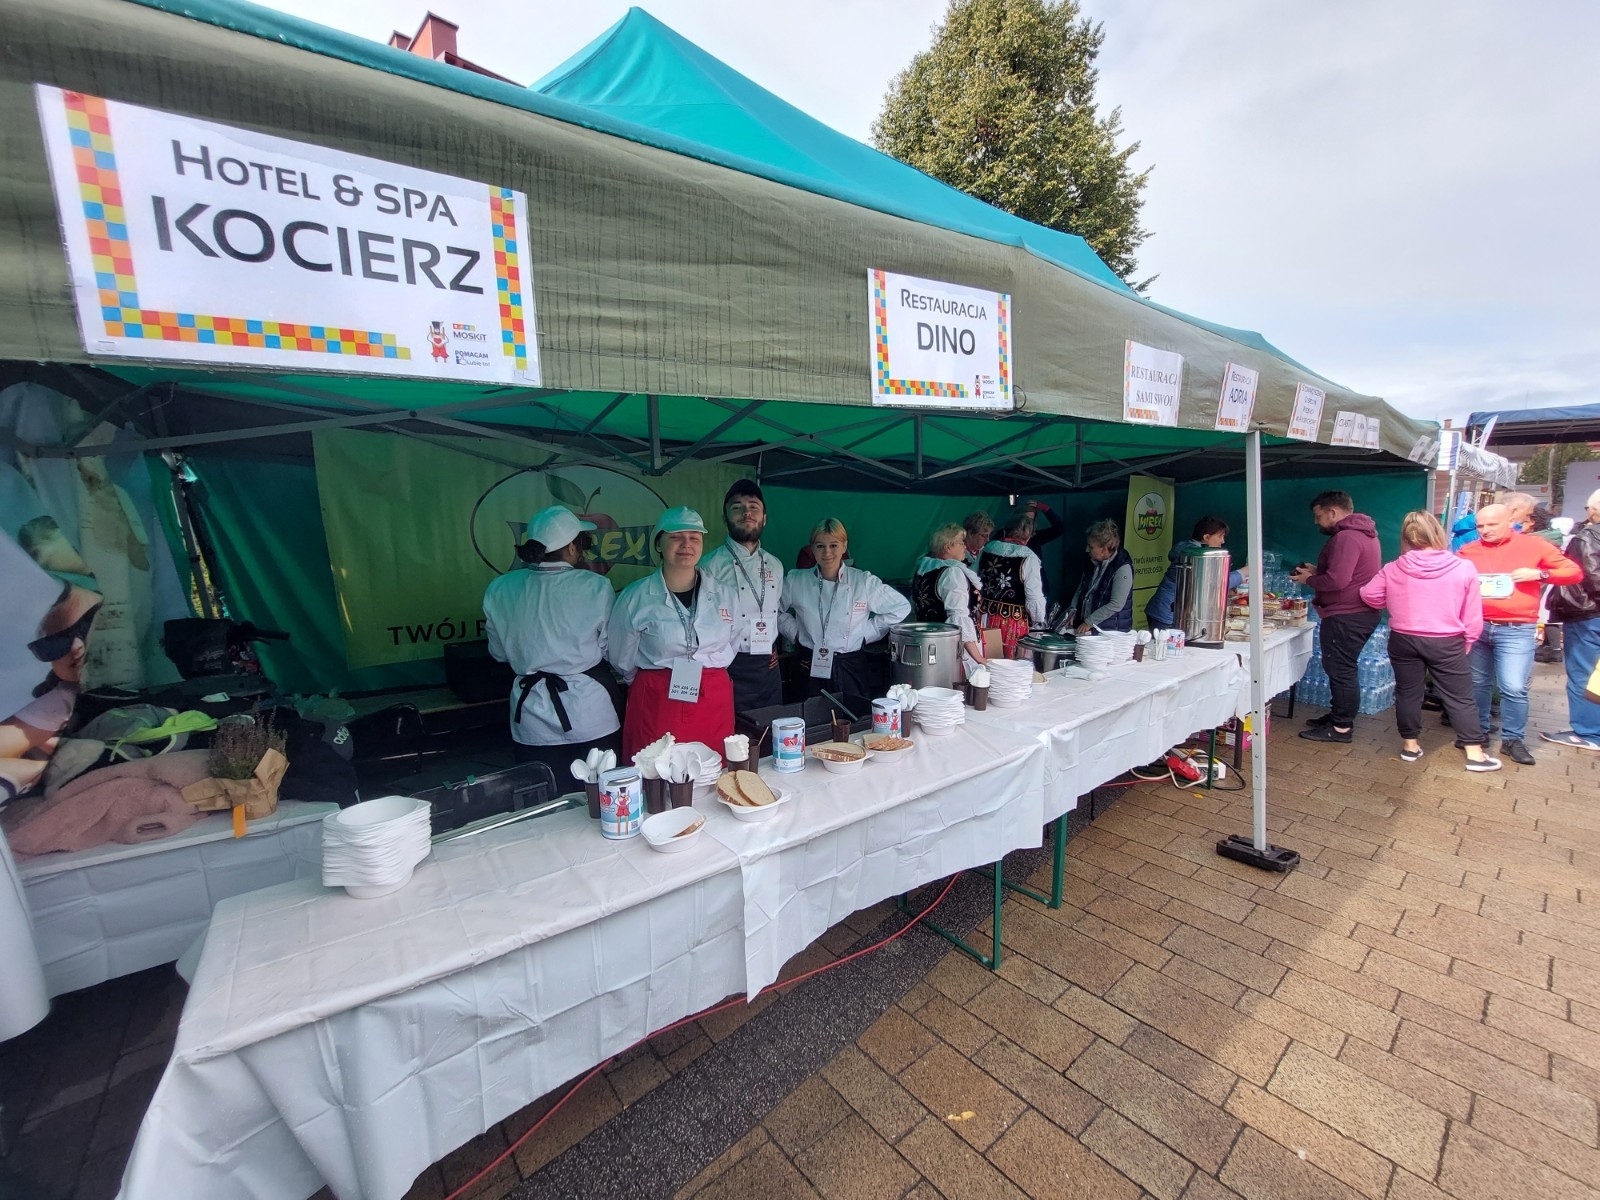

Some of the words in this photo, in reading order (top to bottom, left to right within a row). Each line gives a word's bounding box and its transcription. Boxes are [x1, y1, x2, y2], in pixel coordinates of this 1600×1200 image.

[171, 139, 321, 201] HOTEL
[332, 174, 363, 207] &
[373, 183, 458, 227] SPA
[151, 195, 485, 295] KOCIERZ
[901, 288, 988, 321] RESTAURACJA
[454, 350, 489, 359] POMAGAM
[917, 322, 976, 356] DINO
[1153, 392, 1174, 407] SWOI
[387, 617, 466, 646] TWÓJ
